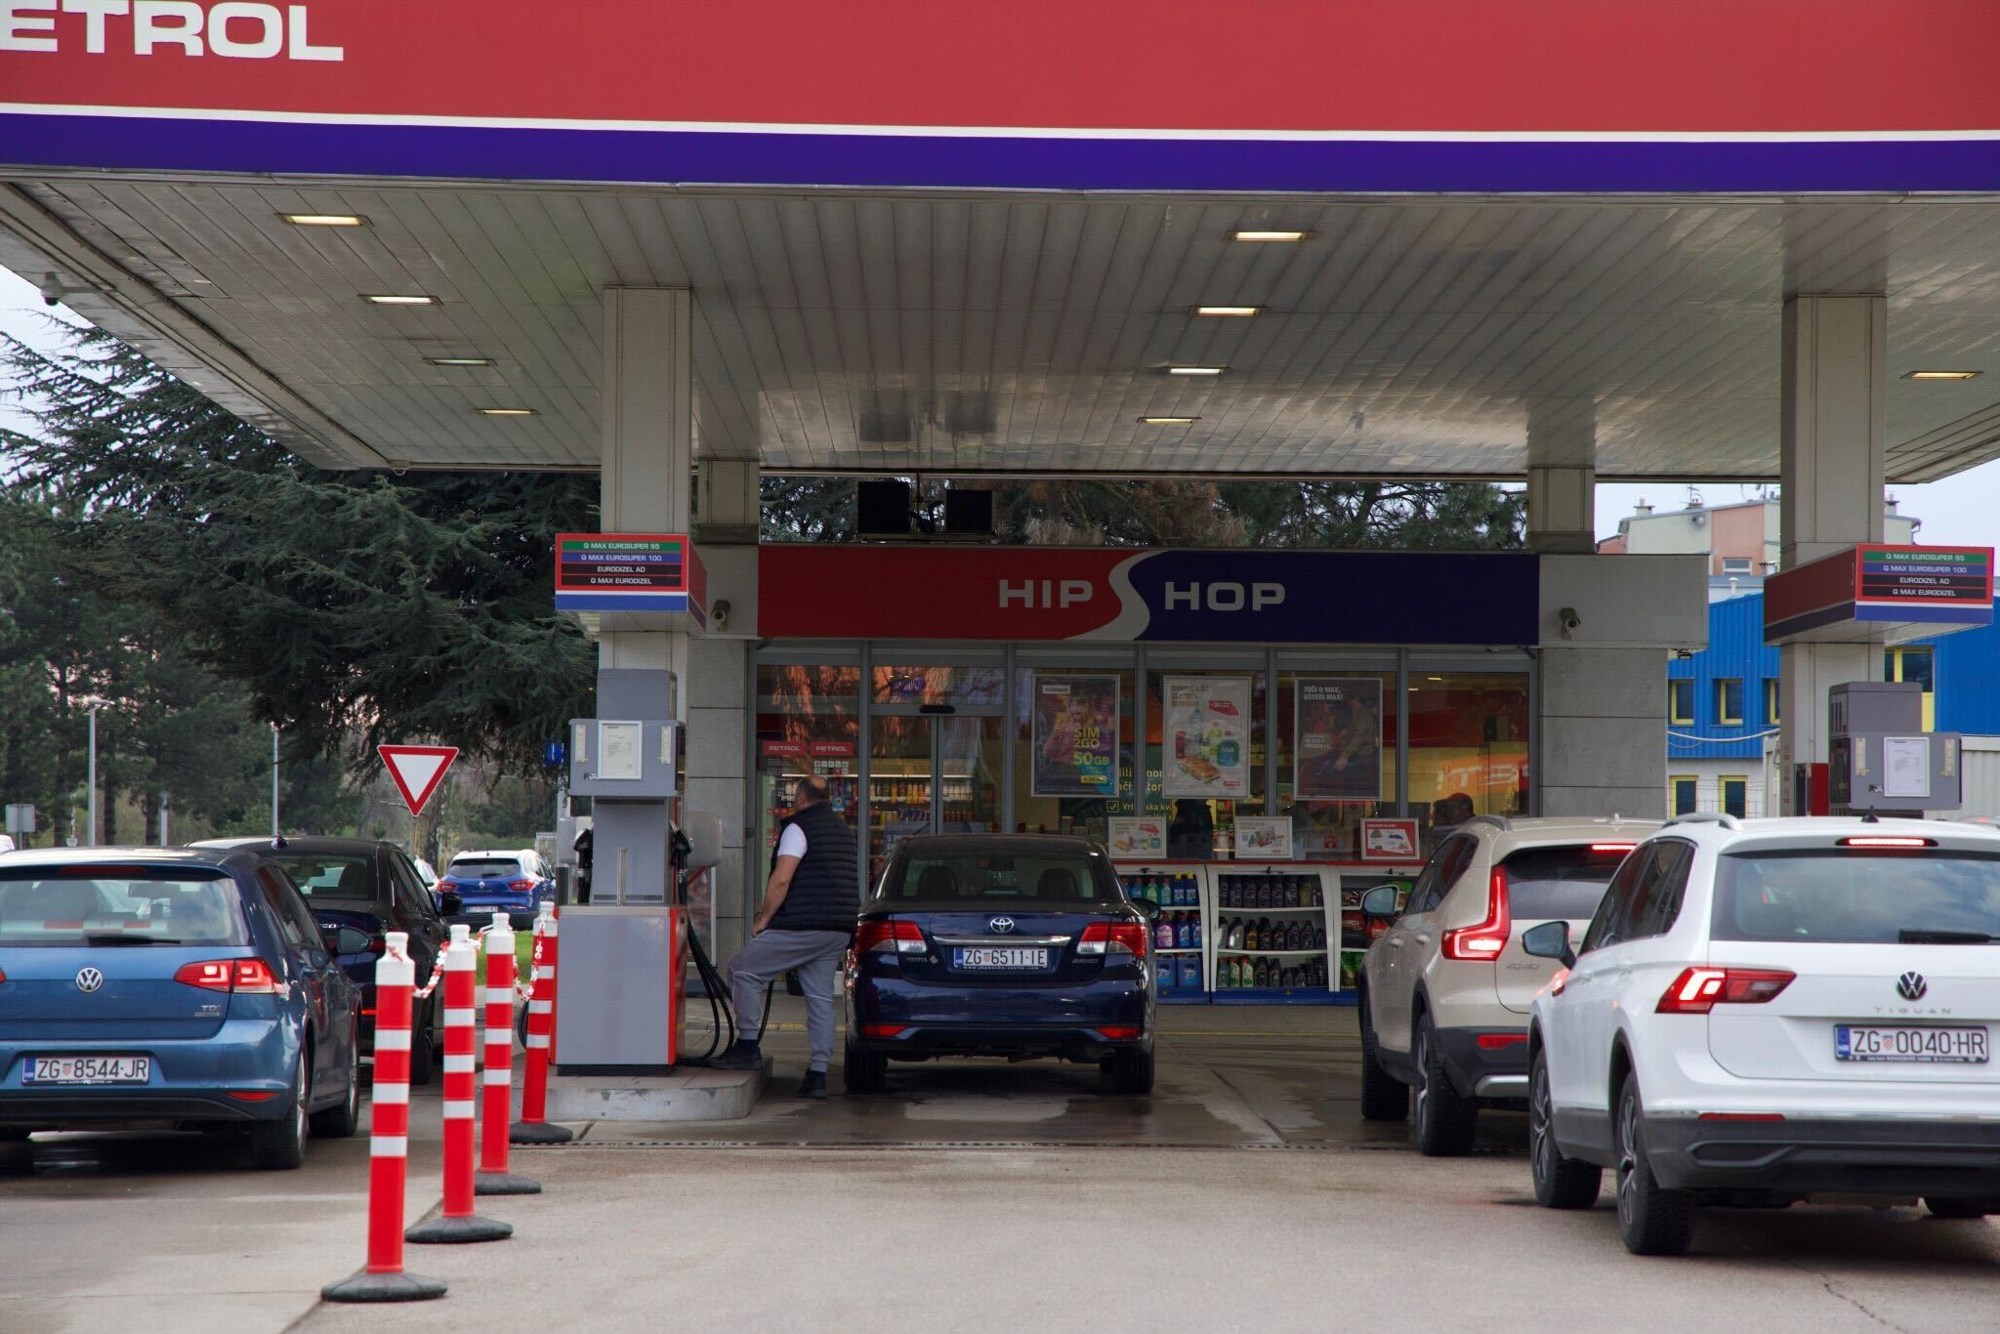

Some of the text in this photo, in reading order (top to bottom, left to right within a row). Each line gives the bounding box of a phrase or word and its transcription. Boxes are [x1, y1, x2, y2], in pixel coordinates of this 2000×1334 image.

[608, 542, 649, 550] EUROSUPER
[581, 554, 662, 562] Q MAX EUROSUPER 100
[597, 565, 634, 573] EURODIZEL
[615, 577, 652, 585] EURODIZEL
[1900, 576, 1938, 584] EURODIZEL
[999, 579, 1094, 608] HIP
[1918, 589, 1957, 597] EURODIZEL
[1075, 727, 1100, 738] SIM
[1075, 738, 1100, 748] 2GO
[1074, 752, 1110, 766] 50 GB
[965, 950, 981, 965] ZG
[1853, 1031, 1880, 1053] ZG
[37, 1060, 60, 1079] ZG
